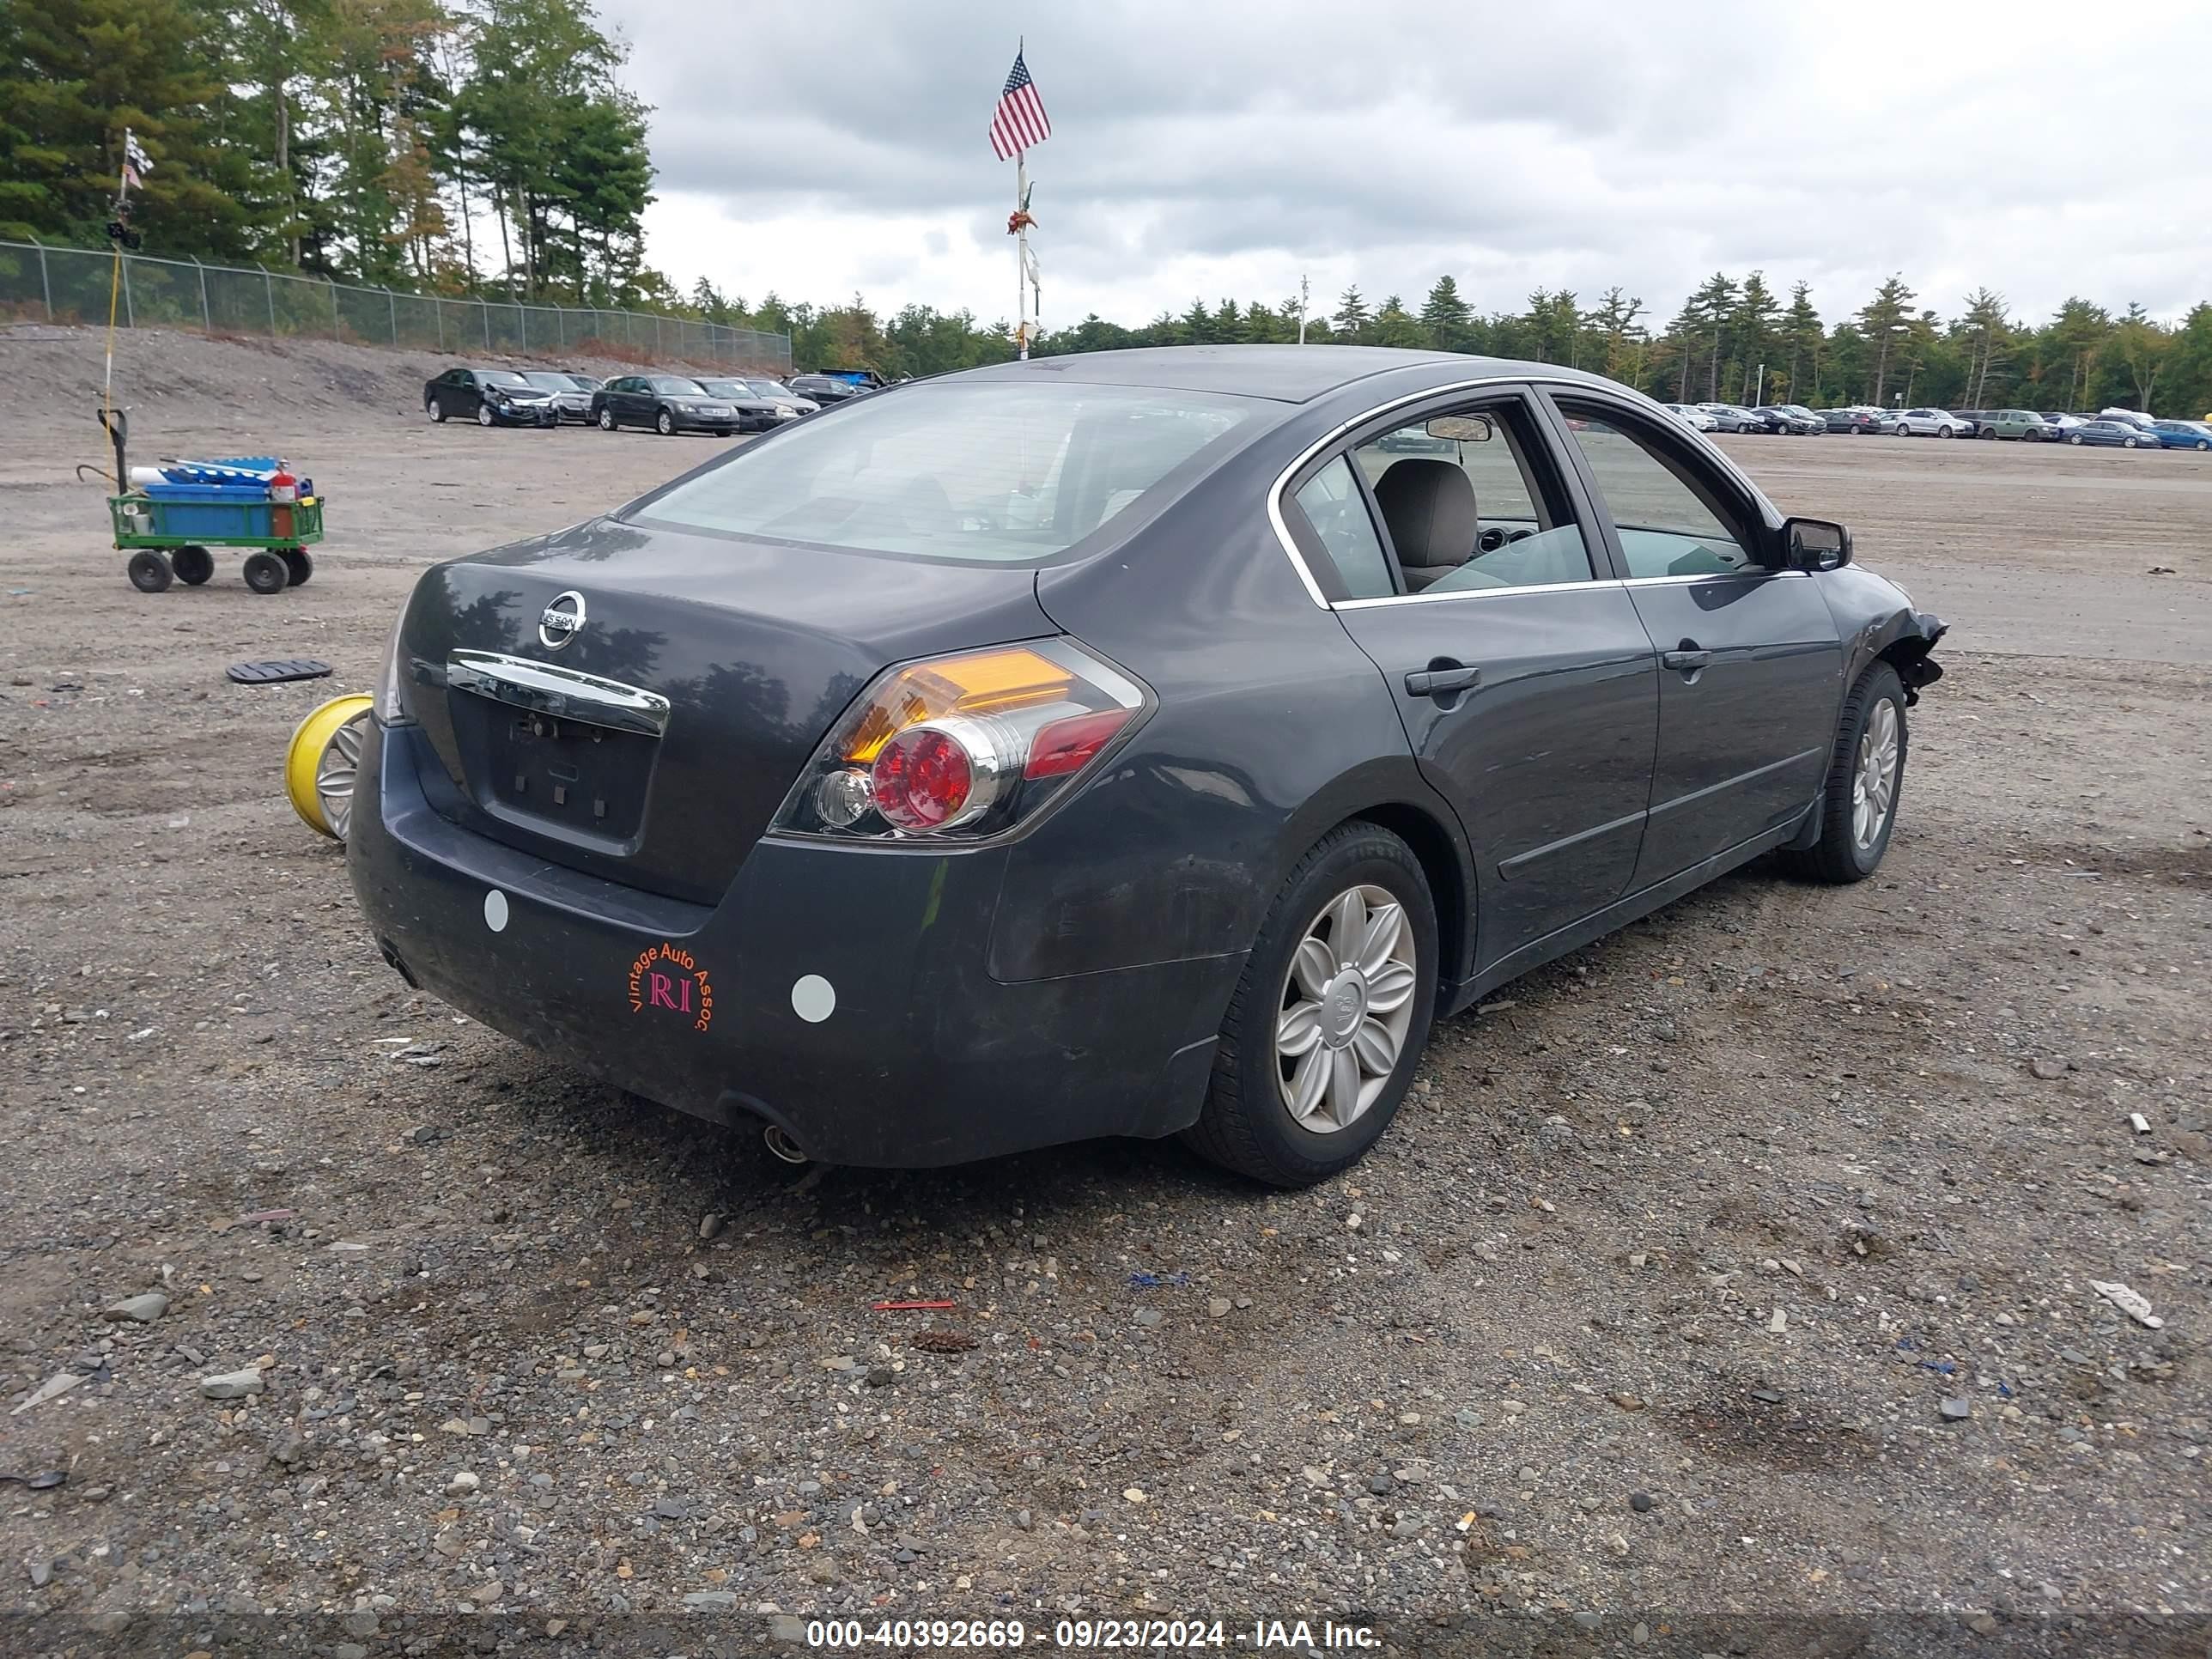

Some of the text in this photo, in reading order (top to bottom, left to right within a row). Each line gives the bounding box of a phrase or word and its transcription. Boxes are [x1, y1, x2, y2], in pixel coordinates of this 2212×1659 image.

[628, 947, 659, 1013] Vintage
[659, 942, 695, 970] Auto
[648, 972, 692, 1013] RI
